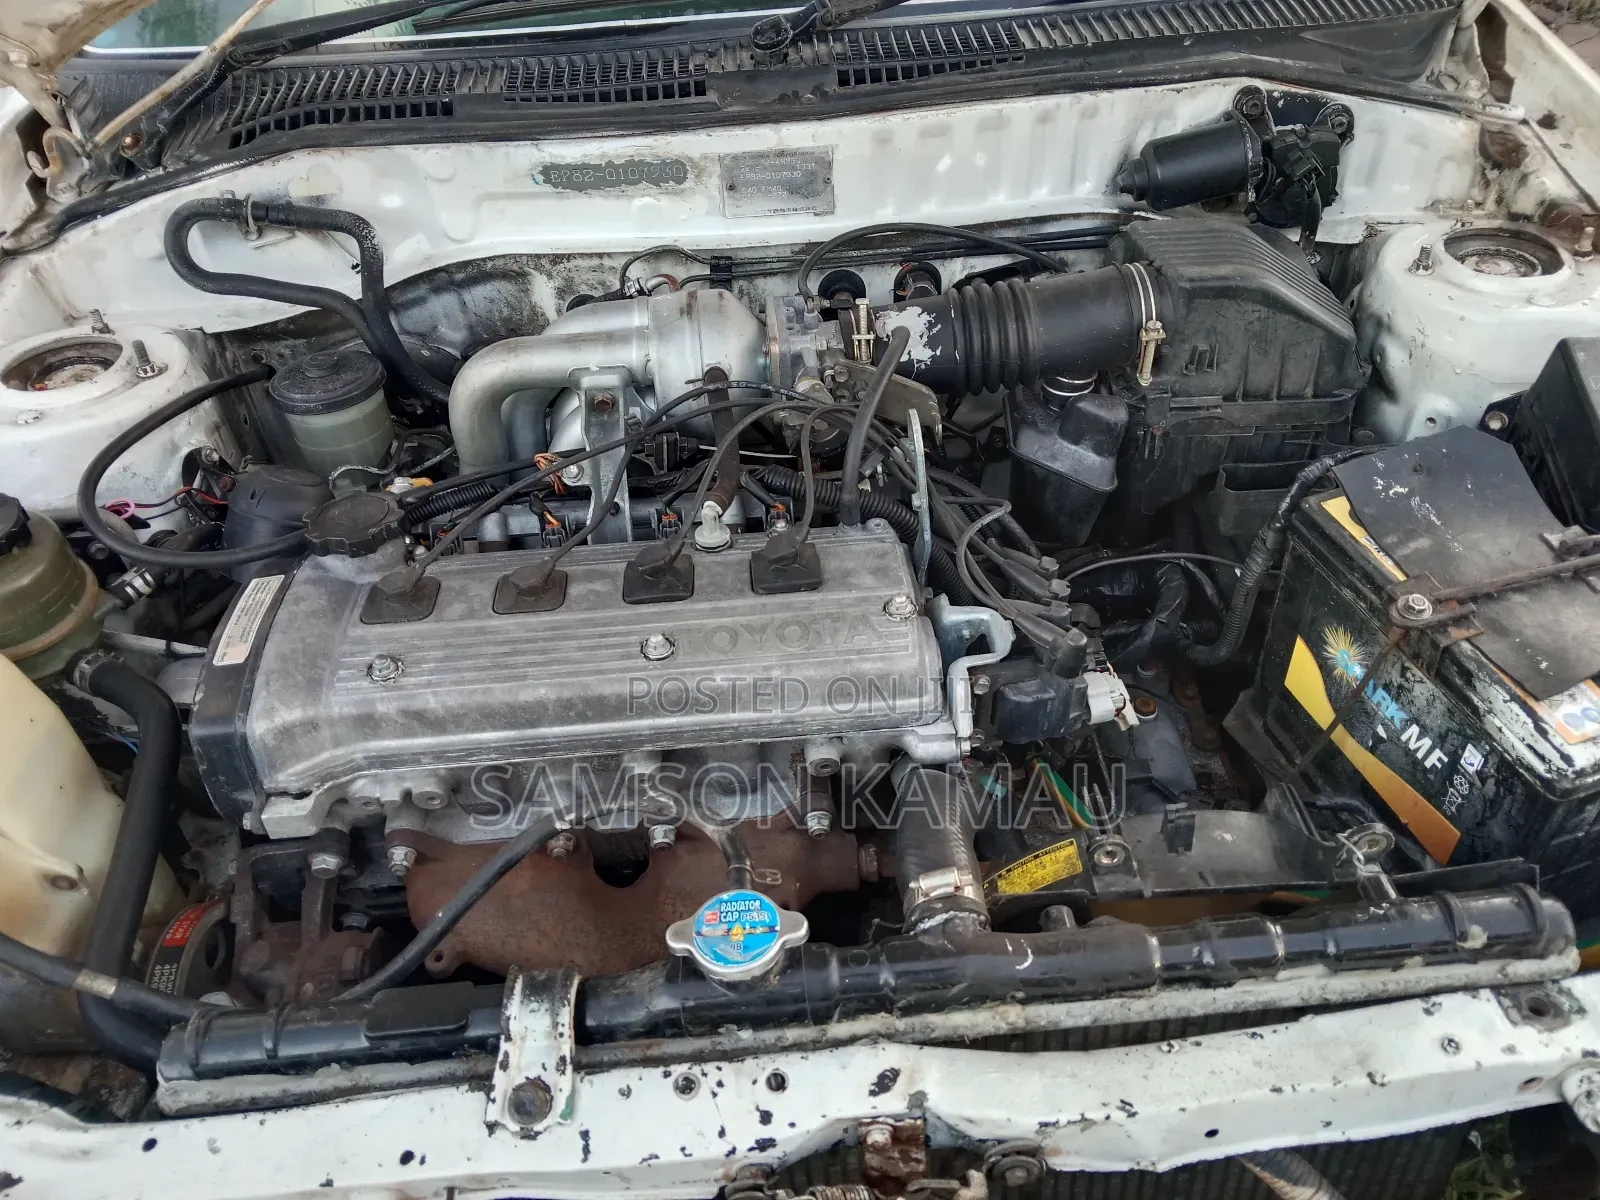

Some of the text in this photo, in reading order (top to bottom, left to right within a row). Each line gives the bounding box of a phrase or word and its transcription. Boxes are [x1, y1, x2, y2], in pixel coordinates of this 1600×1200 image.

[550, 164, 684, 183] EP82-0107930
[678, 612, 884, 653] TOYOTA
[1400, 723, 1449, 770] MF
[720, 899, 761, 912] RADIATOR
[720, 911, 740, 922] CAP
